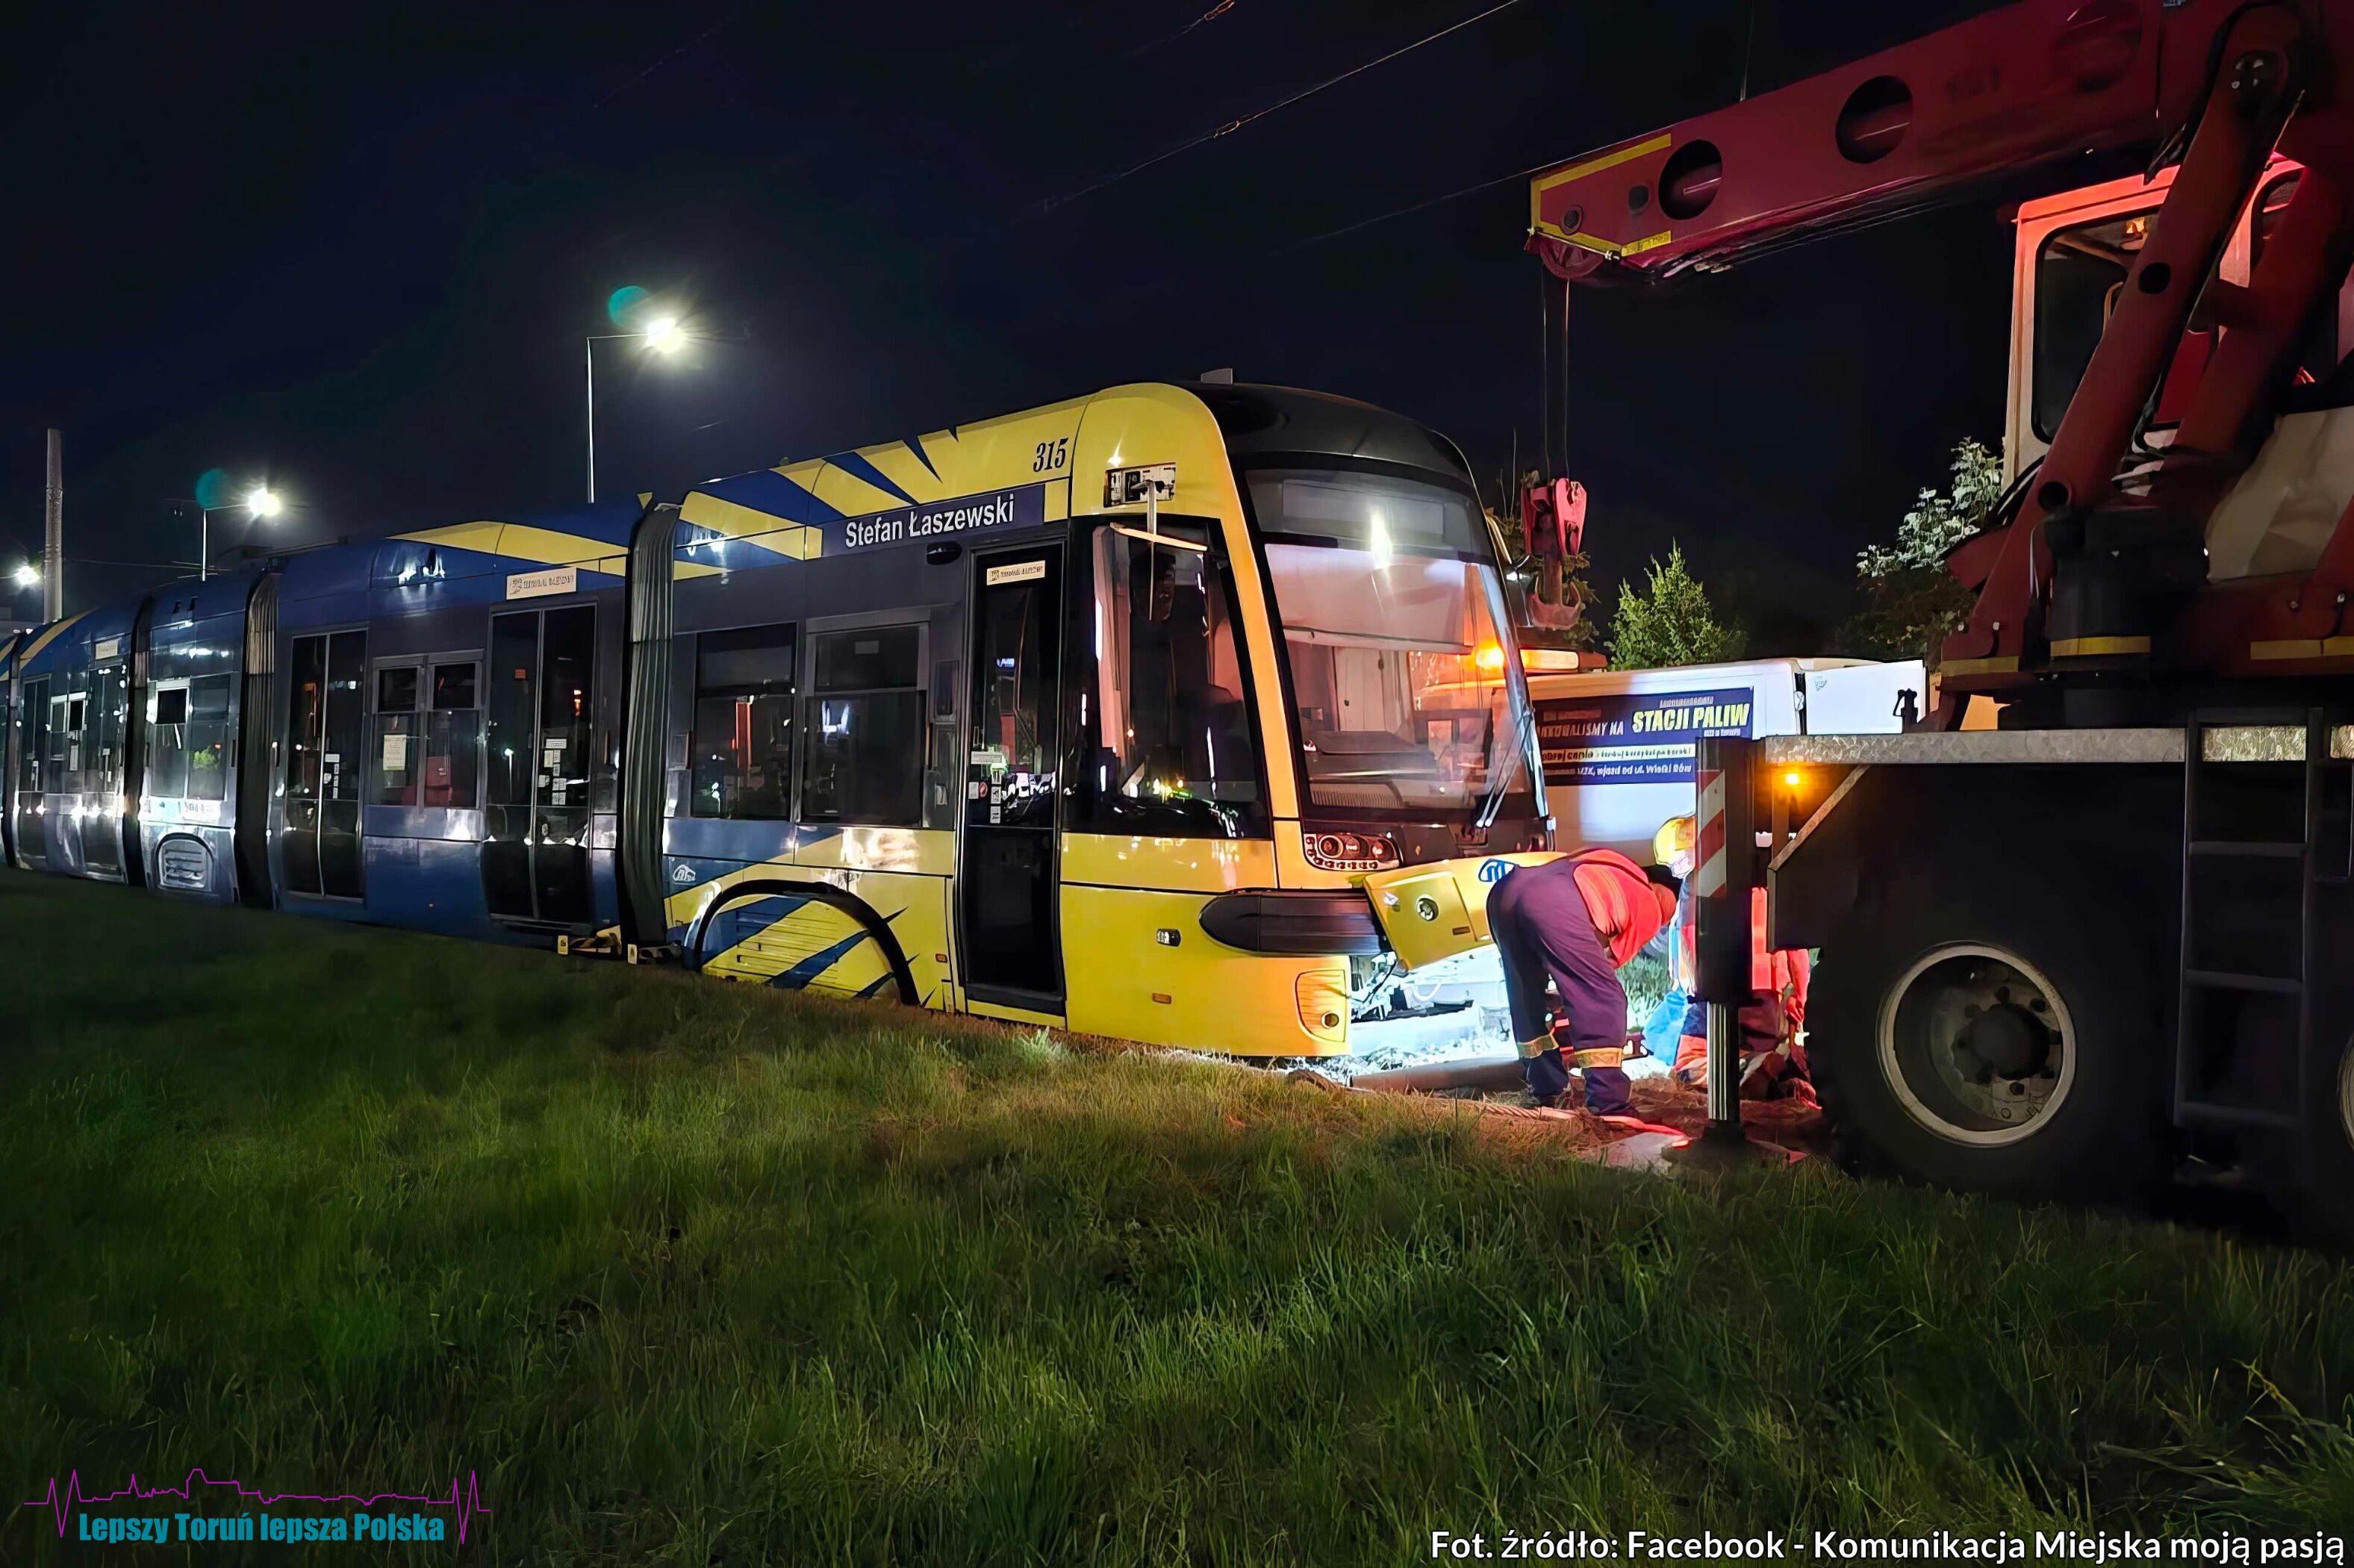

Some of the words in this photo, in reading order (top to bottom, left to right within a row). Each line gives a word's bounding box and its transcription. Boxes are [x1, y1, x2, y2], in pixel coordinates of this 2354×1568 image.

[1033, 438, 1069, 473] 315
[845, 516, 903, 547] Stefan
[909, 494, 1015, 538] Łaszewski
[1631, 708, 1690, 733] STACJI
[1693, 703, 1751, 729] PALIW
